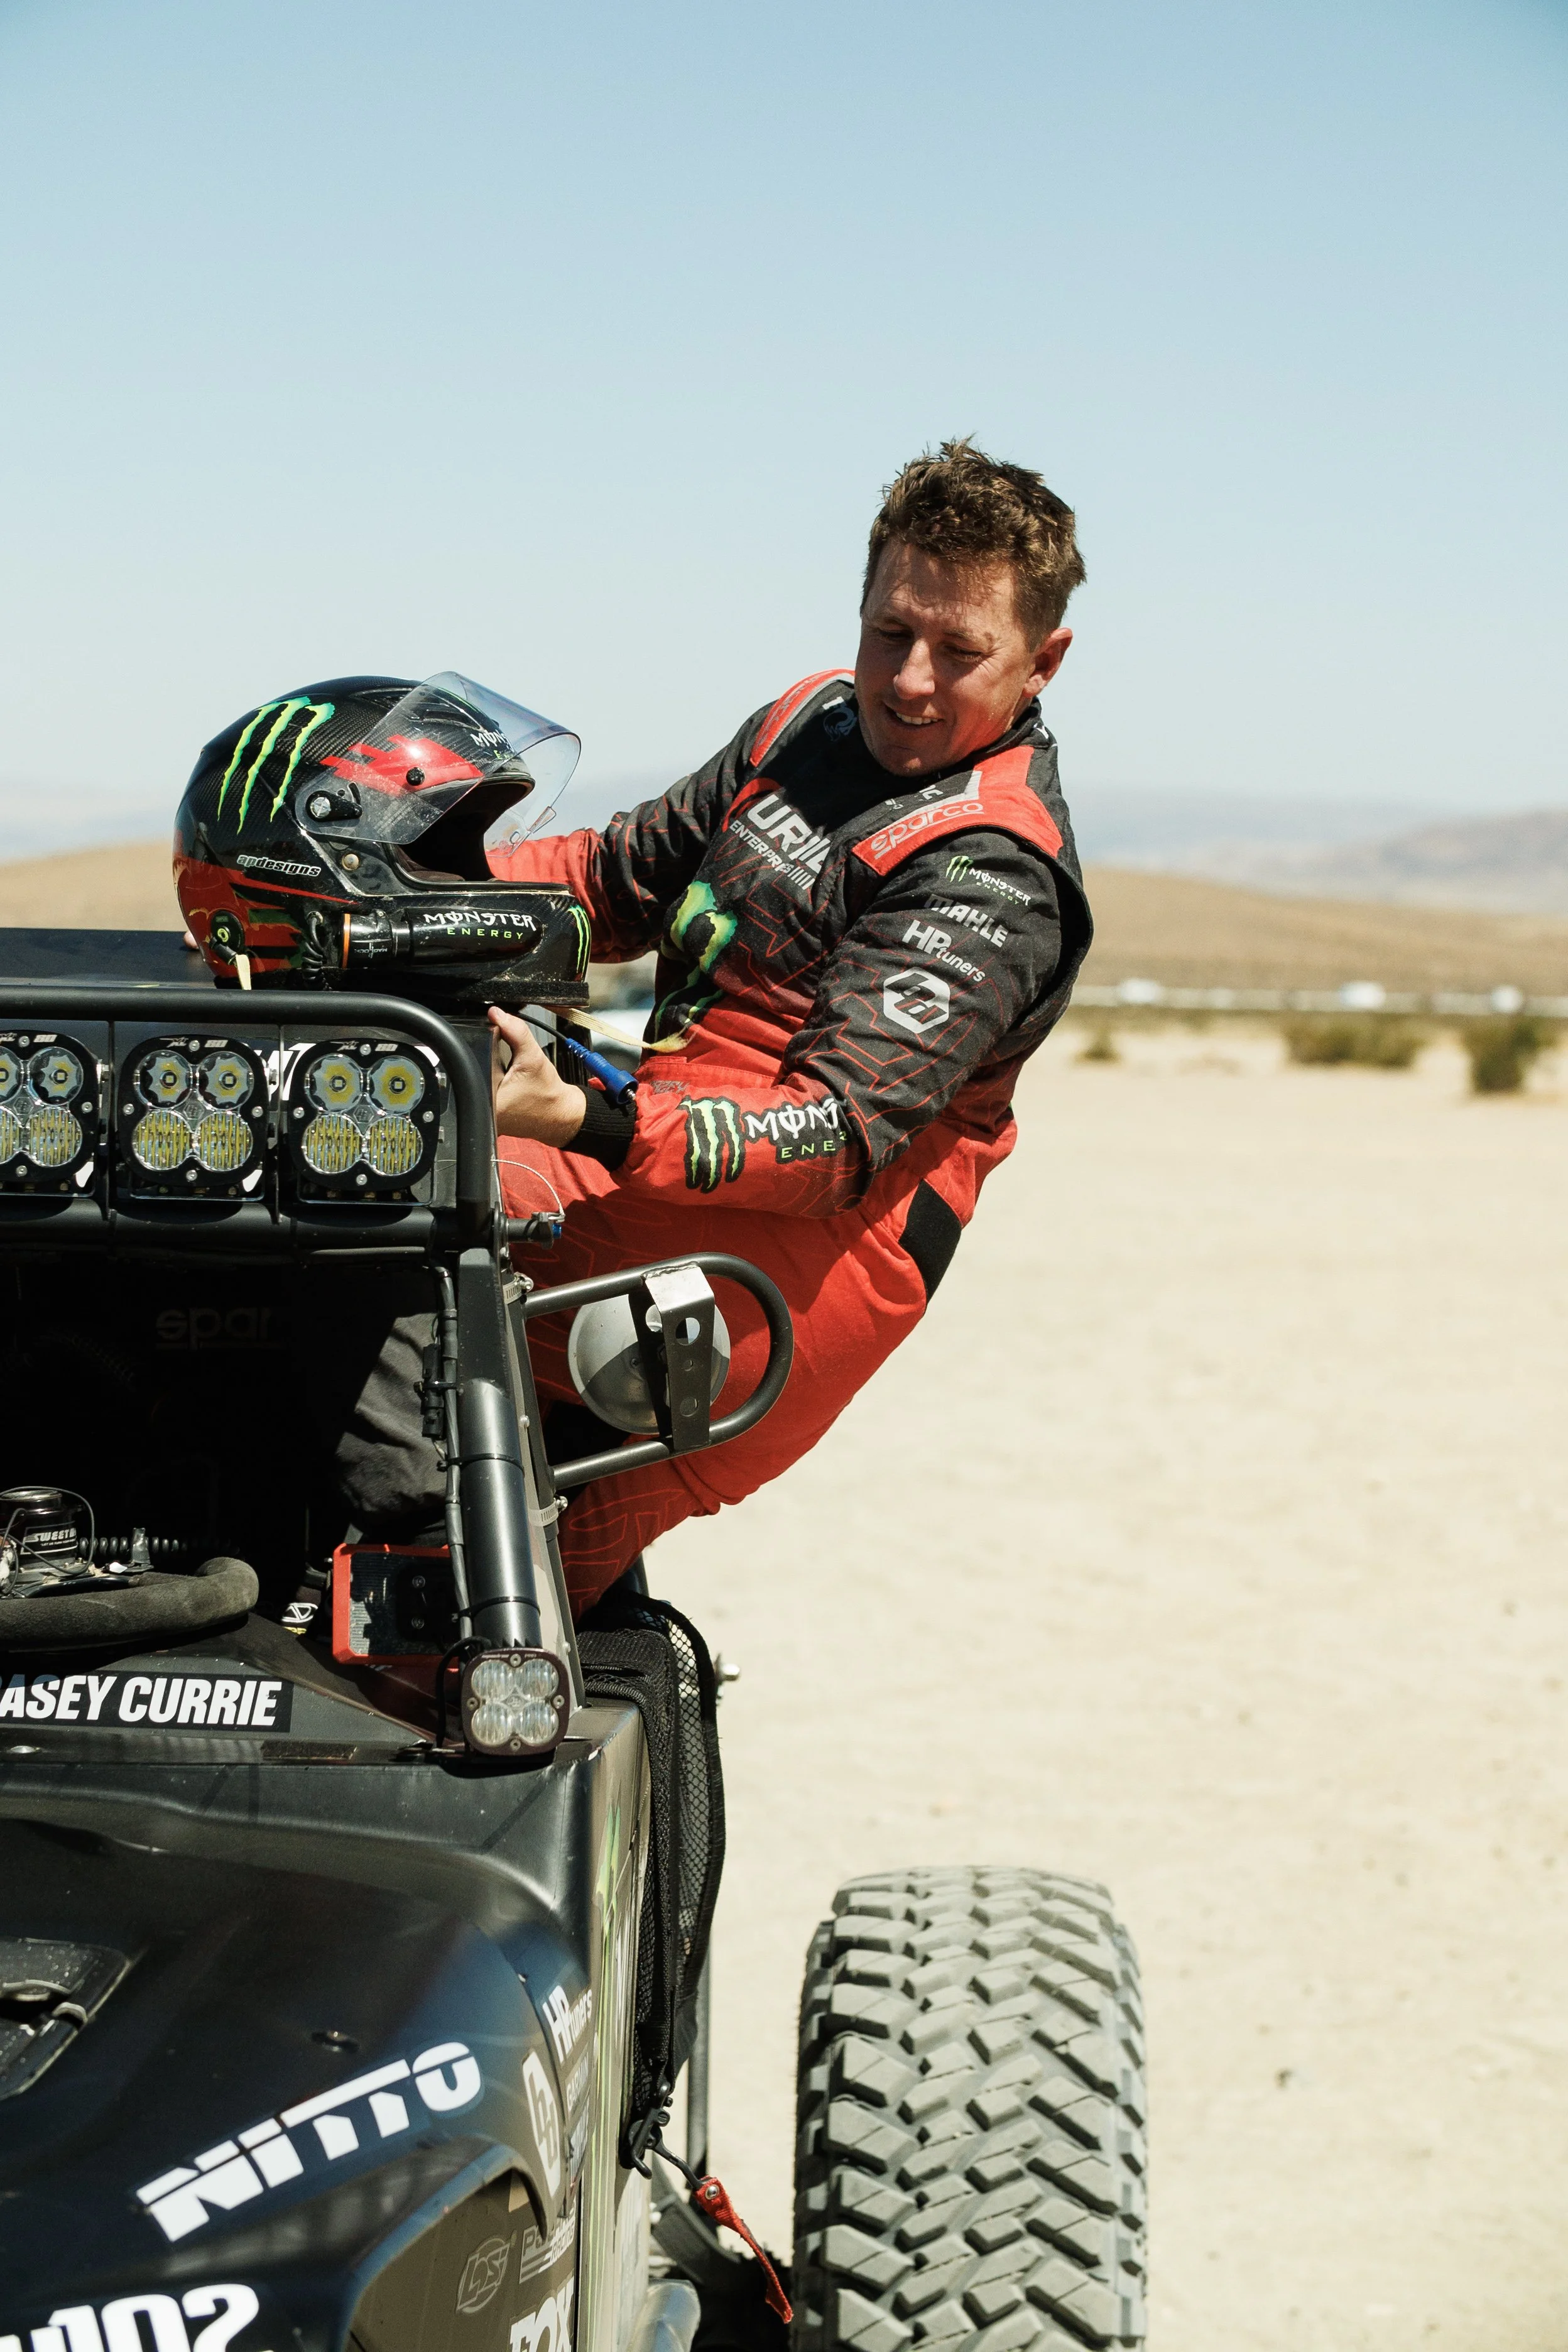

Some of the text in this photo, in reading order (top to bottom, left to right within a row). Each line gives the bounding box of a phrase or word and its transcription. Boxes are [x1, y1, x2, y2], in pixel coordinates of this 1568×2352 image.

[871, 802, 984, 854] sparco
[237, 854, 322, 876] apdesigns
[447, 927, 523, 940] ENERGY
[924, 894, 1008, 947] MAHLE
[0, 1674, 282, 1726] ASEY CURRIE
[136, 2041, 481, 2242] NITTO
[509, 2275, 575, 2352] FOX
